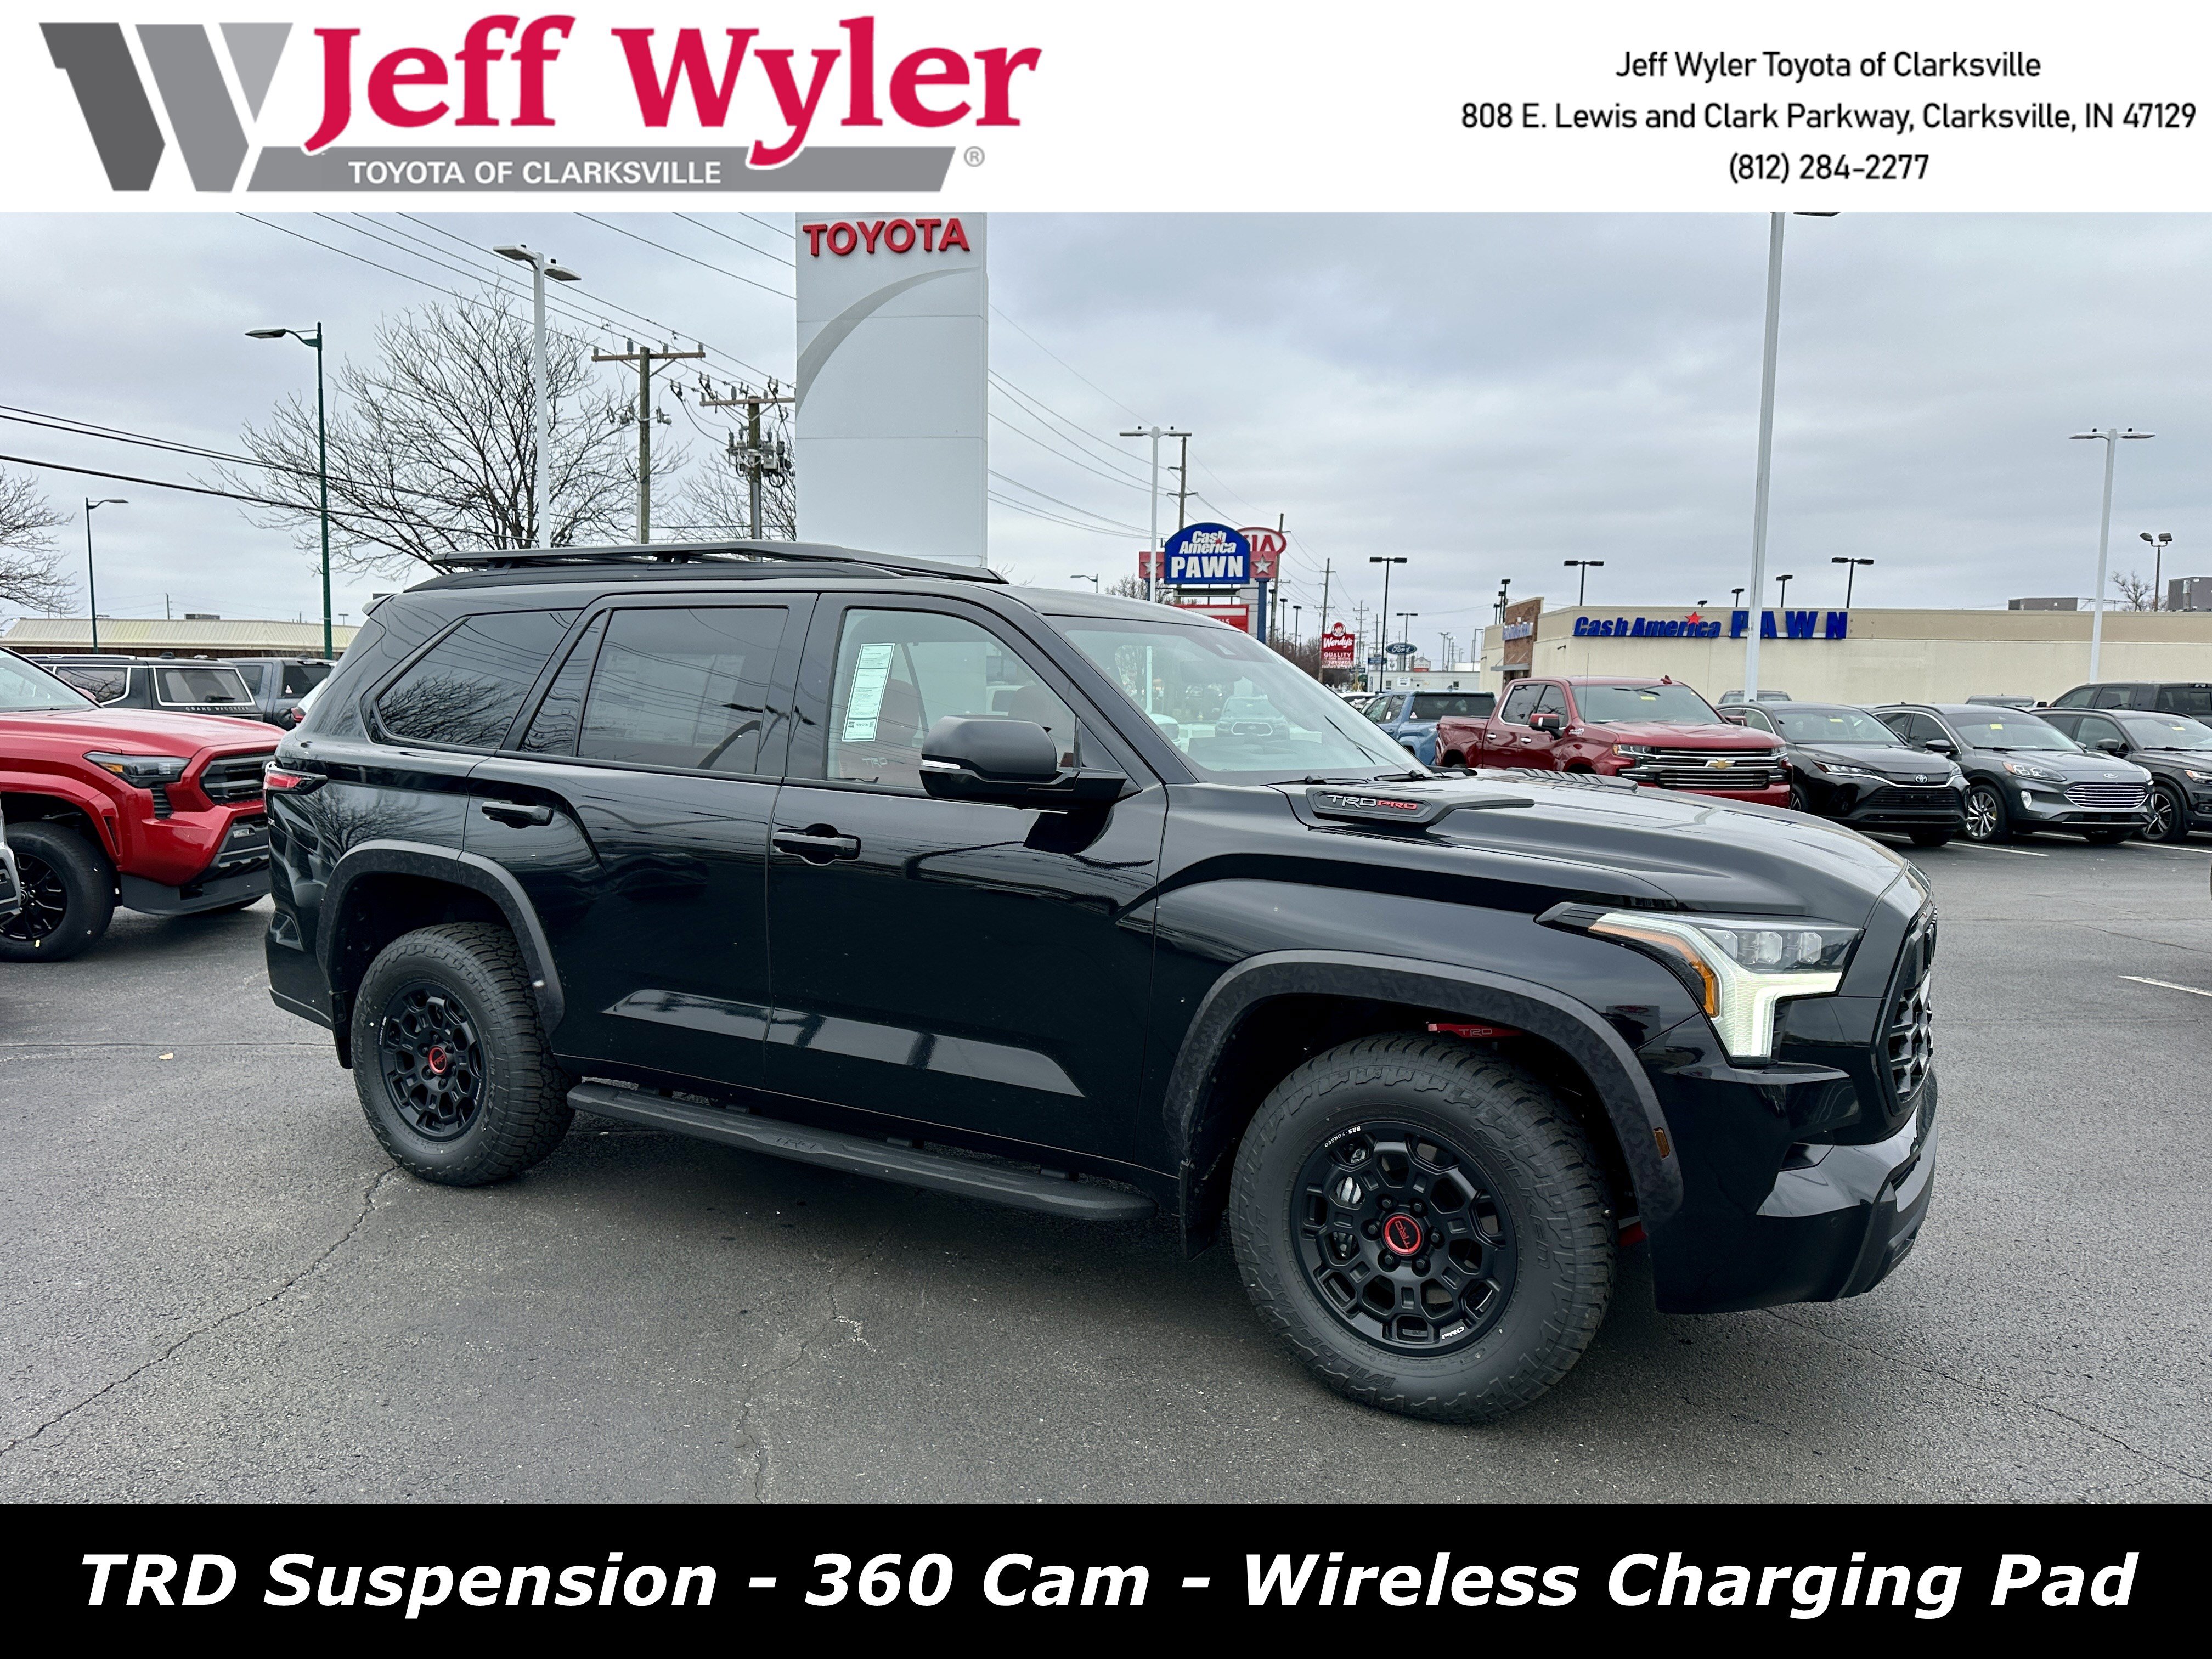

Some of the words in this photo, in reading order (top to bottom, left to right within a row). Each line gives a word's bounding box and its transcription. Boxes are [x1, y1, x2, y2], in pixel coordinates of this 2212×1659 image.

[803, 218, 970, 257] TOYOTA
[1192, 531, 1227, 543] Cash
[1179, 541, 1237, 554] America
[1171, 556, 1244, 578] PAWN
[1574, 616, 1629, 637] Cash
[1630, 617, 1722, 637] America
[1731, 611, 1848, 639] PAWN
[1323, 636, 1353, 648] Wendy's
[1392, 644, 1410, 653] Ford
[862, 757, 888, 769] TRD
[1458, 1028, 1493, 1037] TRD
[1395, 1220, 1411, 1249] TRD
[1441, 1326, 1465, 1340] PRO
